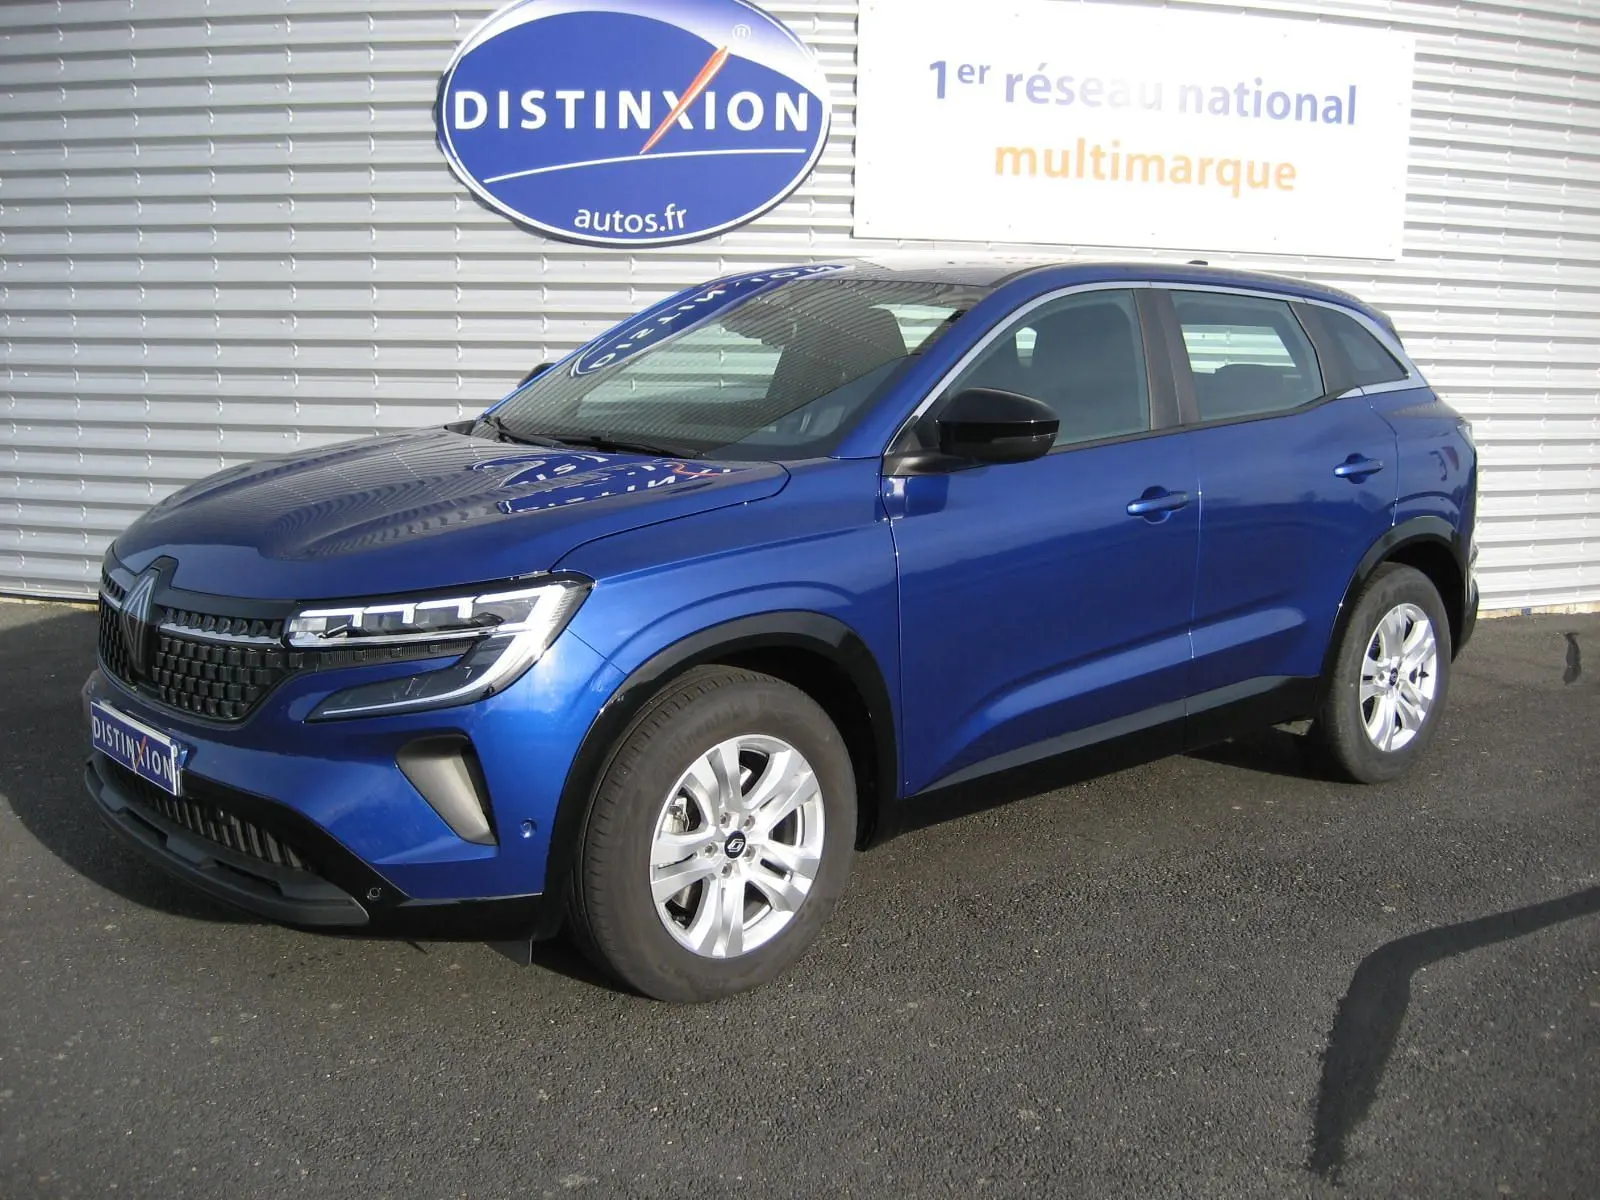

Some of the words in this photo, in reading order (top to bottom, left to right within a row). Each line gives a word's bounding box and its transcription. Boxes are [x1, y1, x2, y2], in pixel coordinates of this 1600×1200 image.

[1005, 65, 1163, 111] réseau
[1179, 78, 1357, 125] national
[995, 138, 1297, 198] multimarque
[574, 203, 687, 233] autos.fr
[93, 716, 173, 782] DISTINXION
